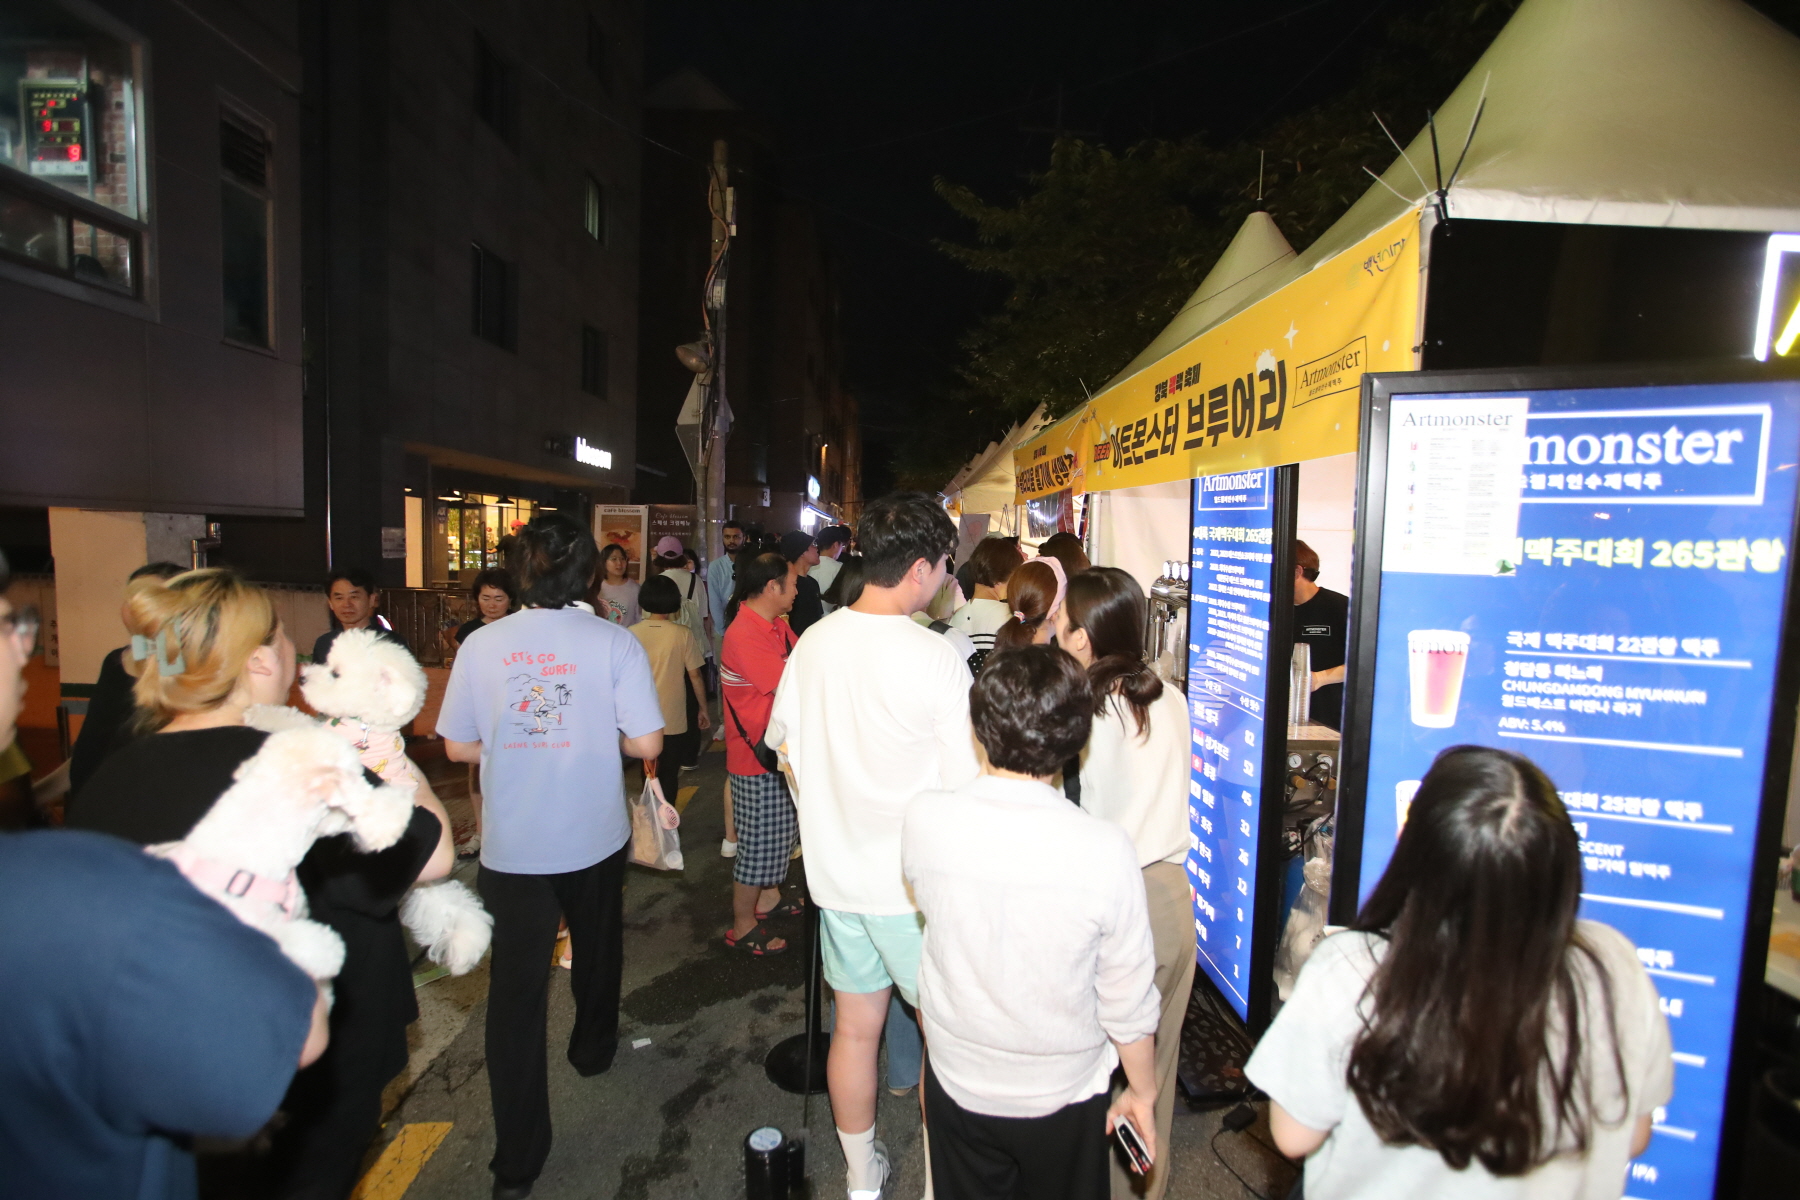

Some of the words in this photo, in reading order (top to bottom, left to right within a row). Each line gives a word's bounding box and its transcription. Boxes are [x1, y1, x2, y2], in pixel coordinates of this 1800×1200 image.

[1300, 350, 1360, 390] Artmonster
[1110, 402, 1179, 470] 아트몬스터
[1183, 359, 1287, 451] 브루어리
[1402, 412, 1513, 427] Artmonster
[576, 436, 612, 471] blossom
[1203, 470, 1264, 492] Artmonster
[1649, 537, 1786, 574] 265관왕
[1505, 631, 1541, 649] 국제
[1544, 633, 1615, 653] 맥주대회
[1617, 636, 1678, 655] 22관왕
[502, 651, 534, 666] LET'S
[537, 653, 556, 664] GO
[540, 663, 577, 677] SURF!!
[1501, 681, 1625, 699] CHUNGDAMDONG
[1498, 716, 1530, 730] ABV:
[1531, 719, 1567, 733] 5.4%
[551, 741, 571, 749] CLUB
[1234, 935, 1242, 950] 7
[1233, 964, 1240, 979] 1
